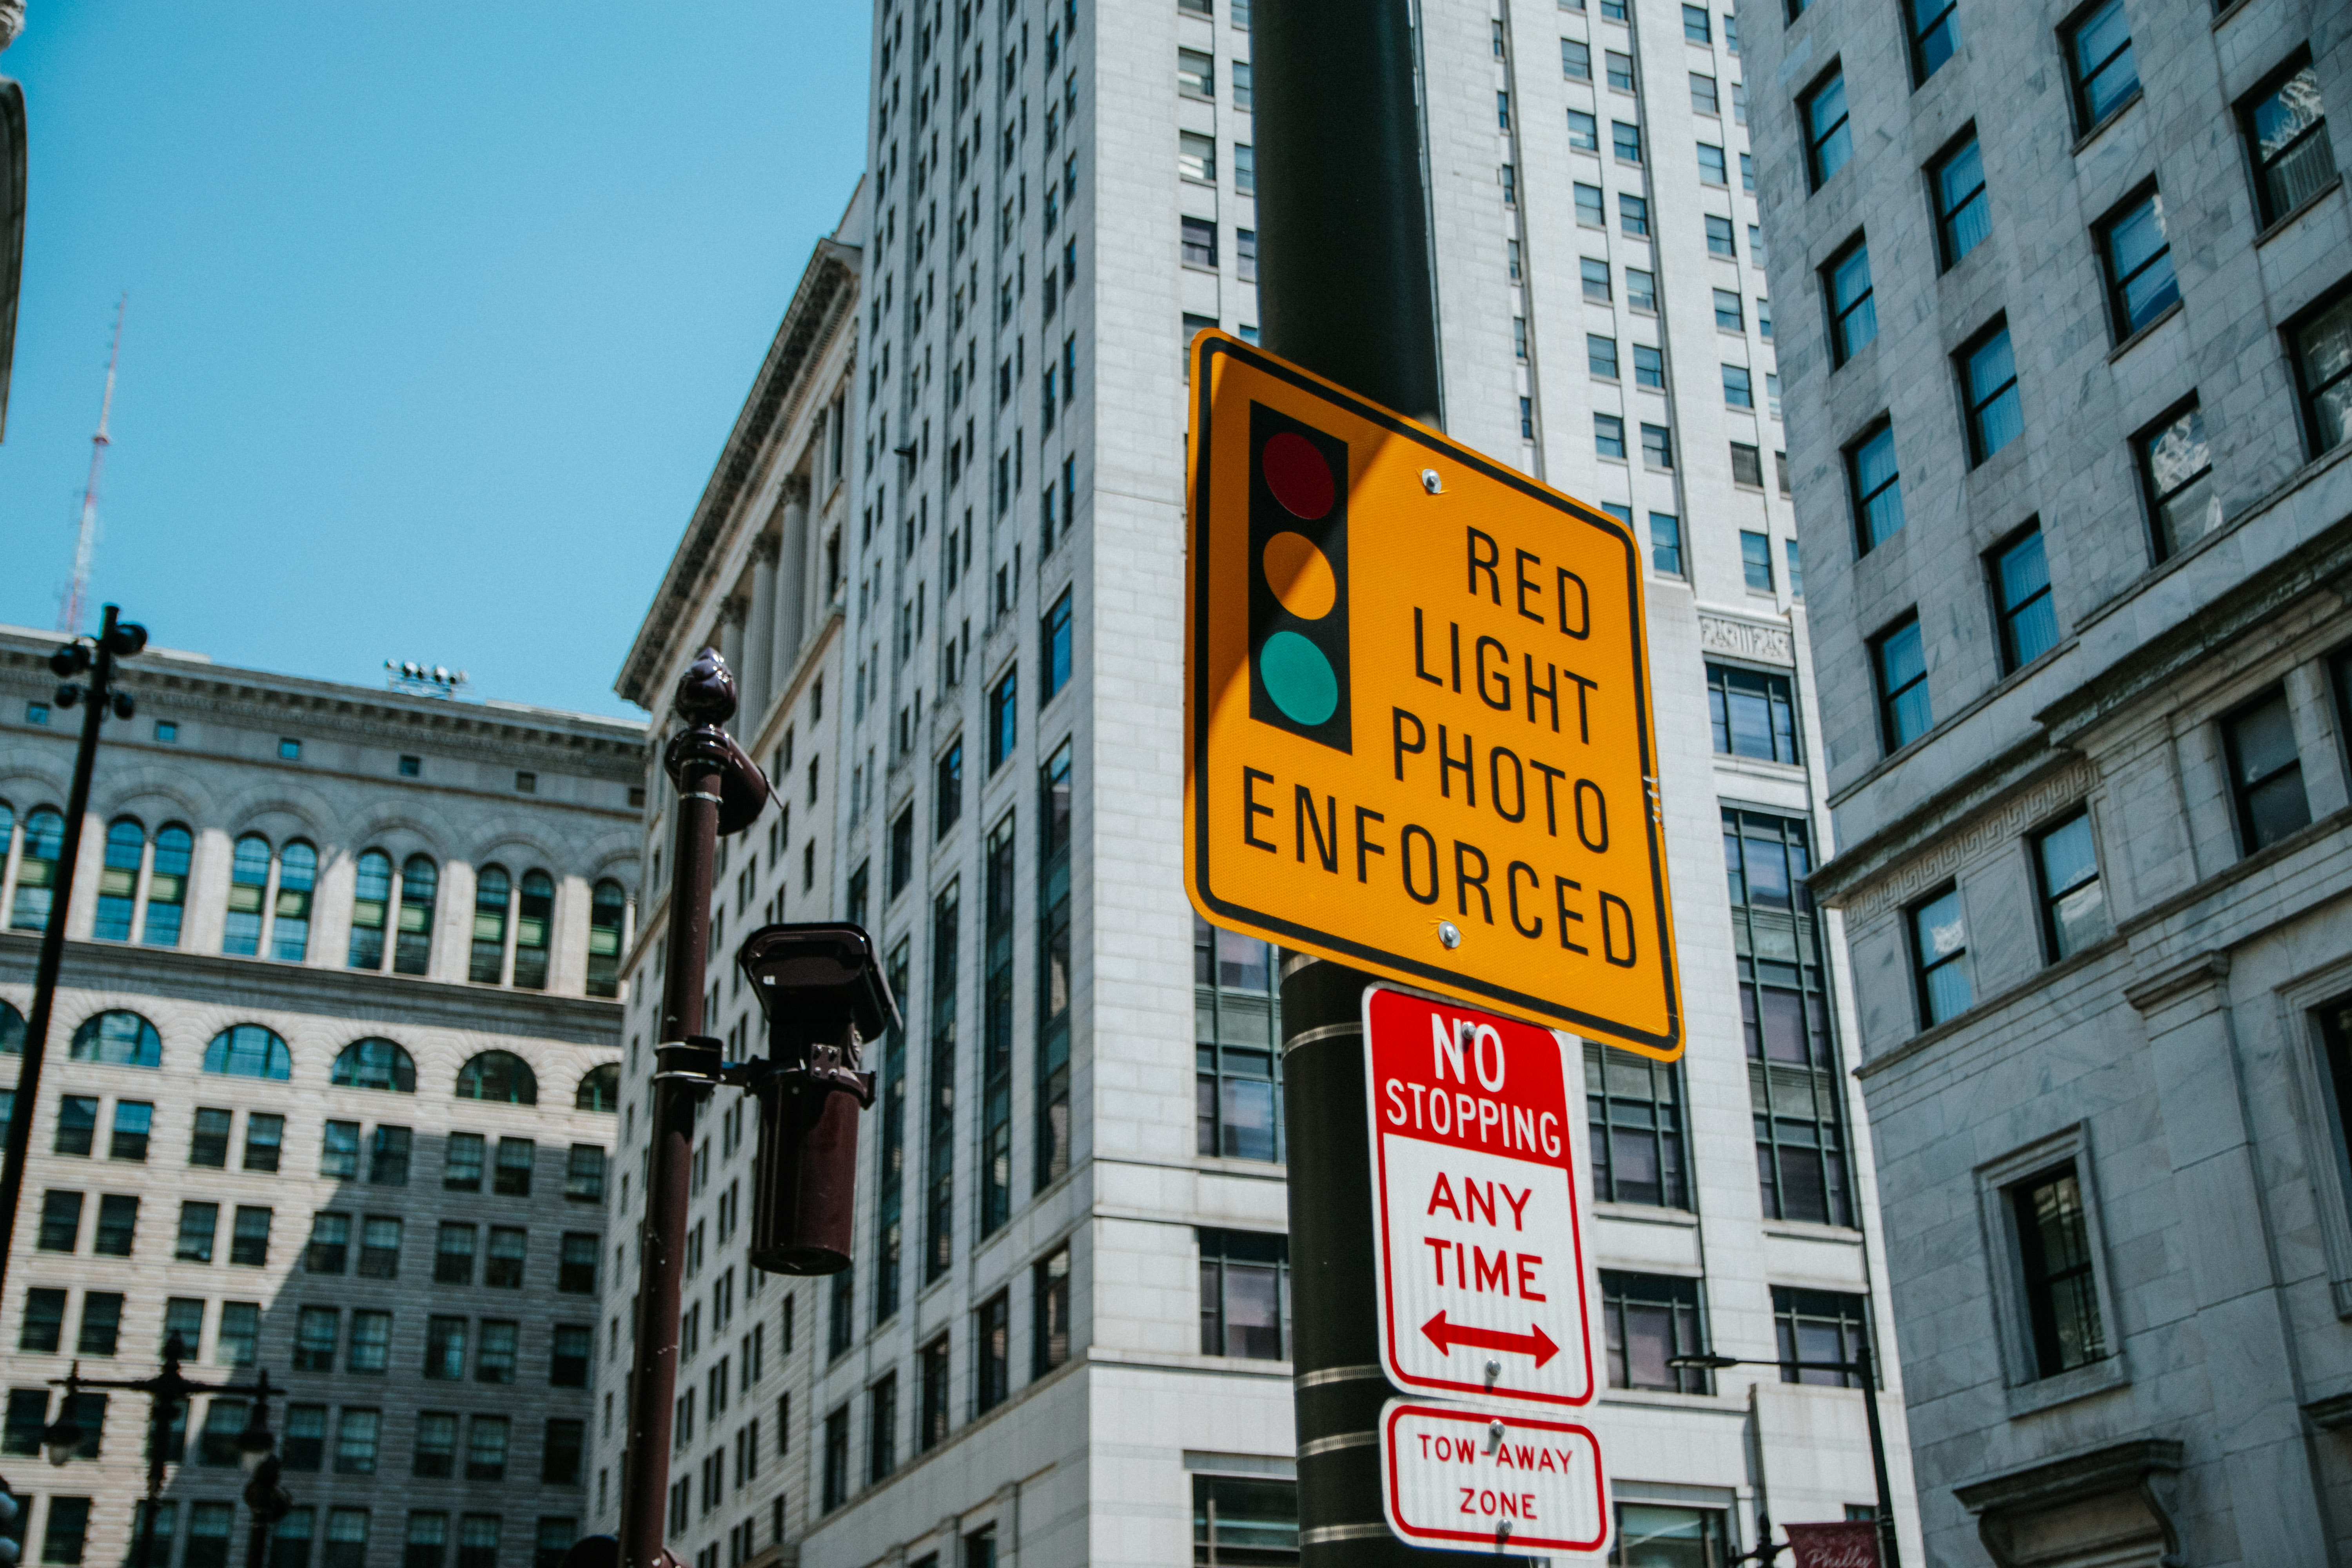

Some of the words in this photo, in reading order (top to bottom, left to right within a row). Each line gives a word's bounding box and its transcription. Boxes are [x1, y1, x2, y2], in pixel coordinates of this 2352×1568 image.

[1468, 526, 1590, 640] RED
[1414, 607, 1597, 744] LIGHT
[1393, 707, 1608, 853] PHOTO
[1244, 766, 1636, 967] ENFORCED
[1432, 1013, 1505, 1093] NO
[1386, 1078, 1561, 1158] STOPPING
[1427, 1172, 1532, 1232] ANY
[1424, 1236, 1546, 1303] TIME
[1417, 1434, 1573, 1474] TOW-AWAY
[1460, 1488, 1537, 1520] ZONE
